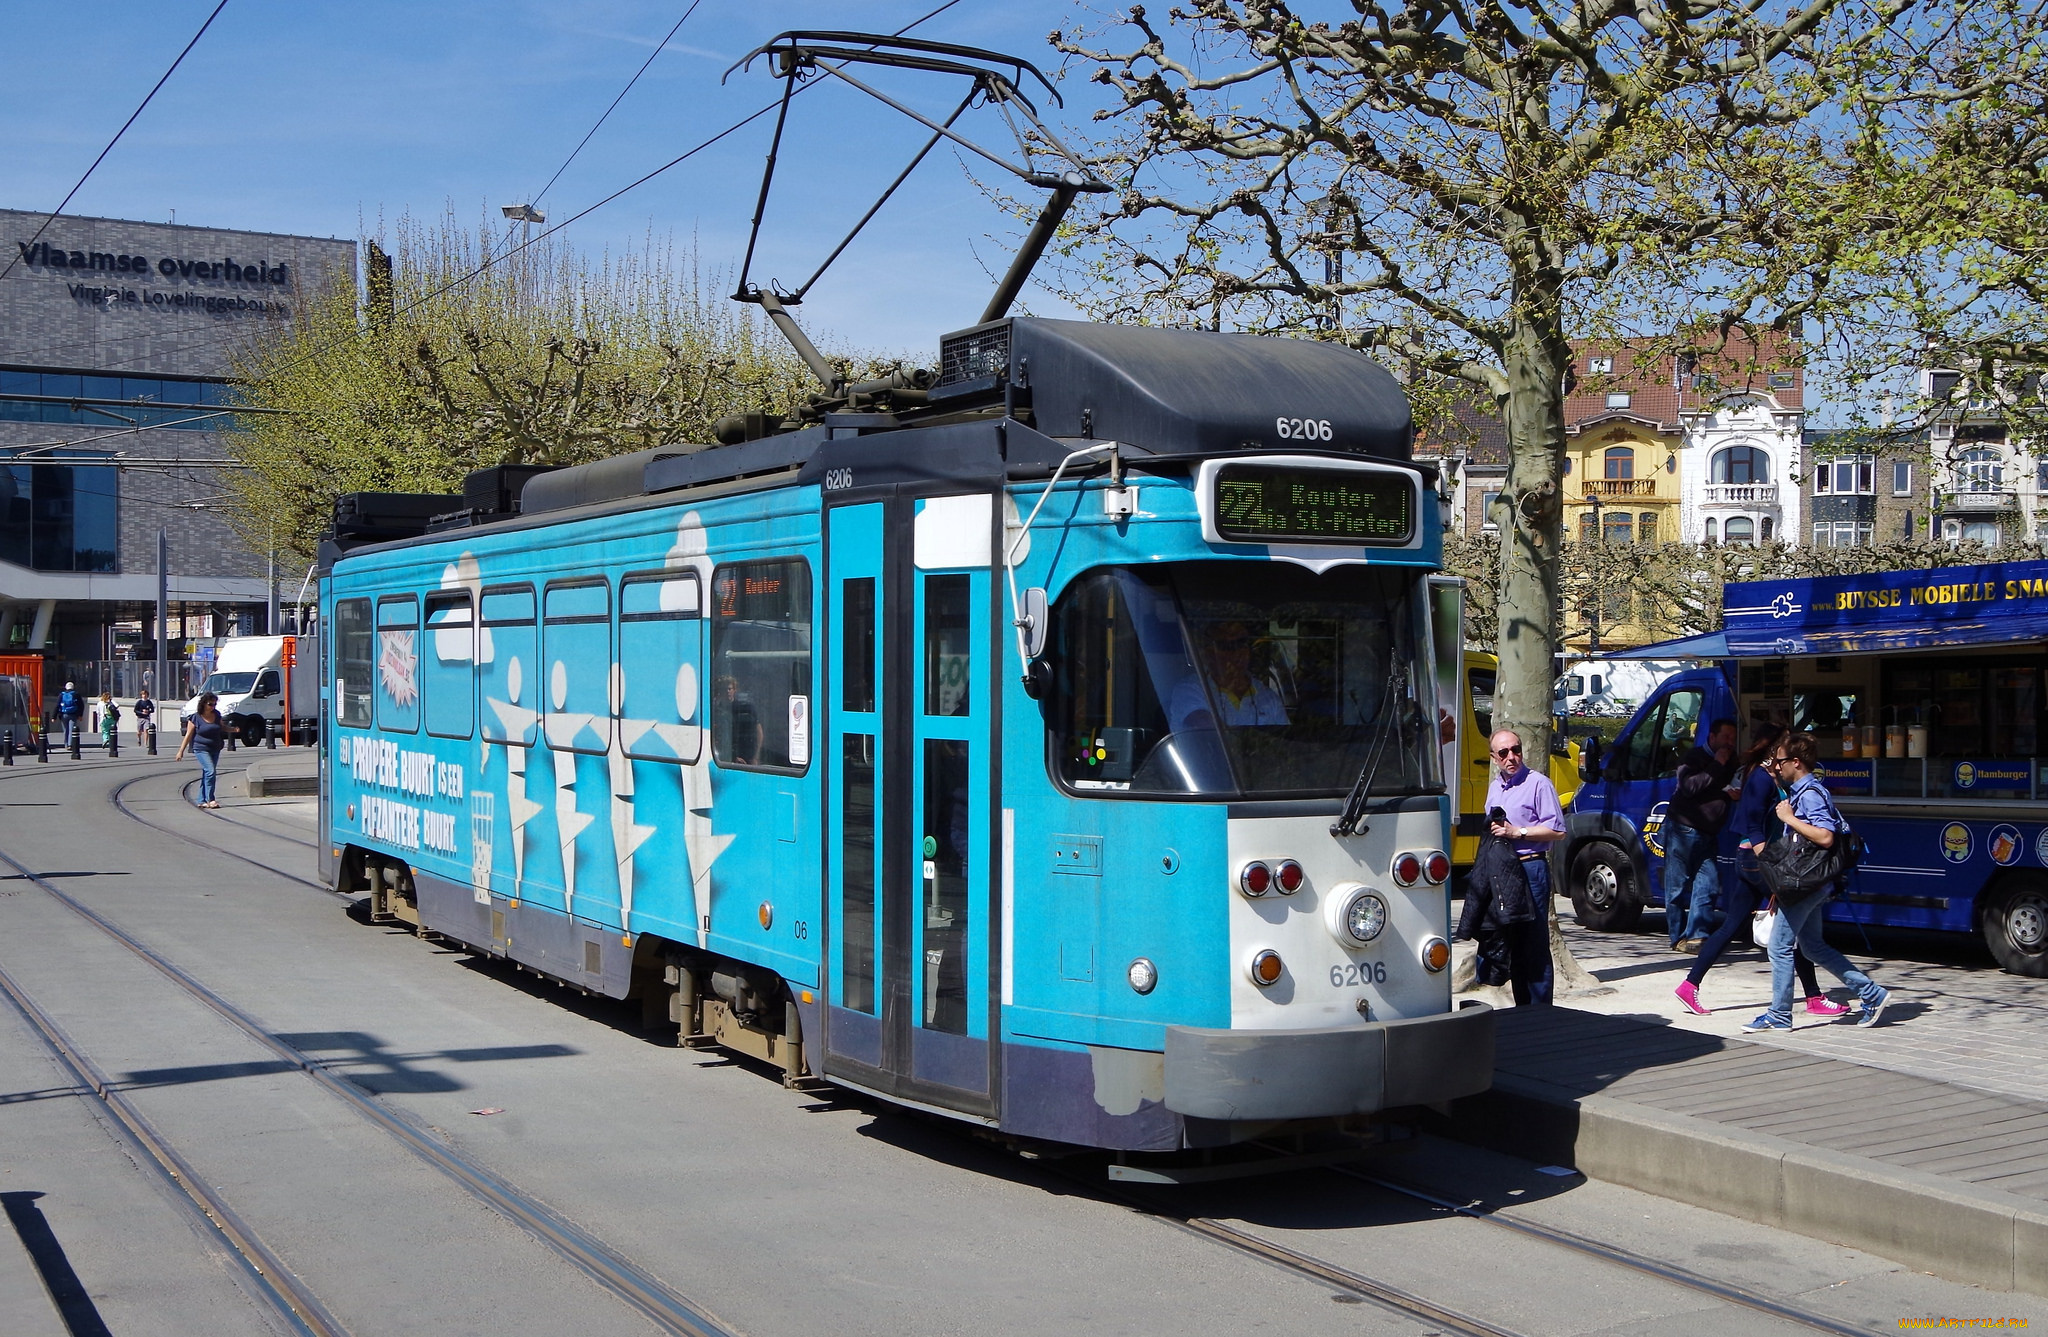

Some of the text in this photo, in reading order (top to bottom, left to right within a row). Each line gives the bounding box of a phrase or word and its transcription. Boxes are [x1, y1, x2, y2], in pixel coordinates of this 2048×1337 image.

[18, 241, 286, 285] Vlaamse overheid
[1276, 416, 1333, 441] 6206
[826, 467, 852, 490] 6206
[1219, 481, 1376, 528] 22 Kouter
[1910, 581, 1995, 606] MOBIELE
[352, 736, 399, 788] PROPERE
[400, 750, 436, 797] BUURT
[438, 761, 447, 795] IS
[447, 764, 463, 799] EEN
[1825, 769, 1870, 778] Braadworst
[1977, 769, 2029, 780] Hamburger
[361, 794, 420, 849] PLEZANTERE
[794, 920, 807, 940] 06
[1329, 961, 1387, 988] 6206
